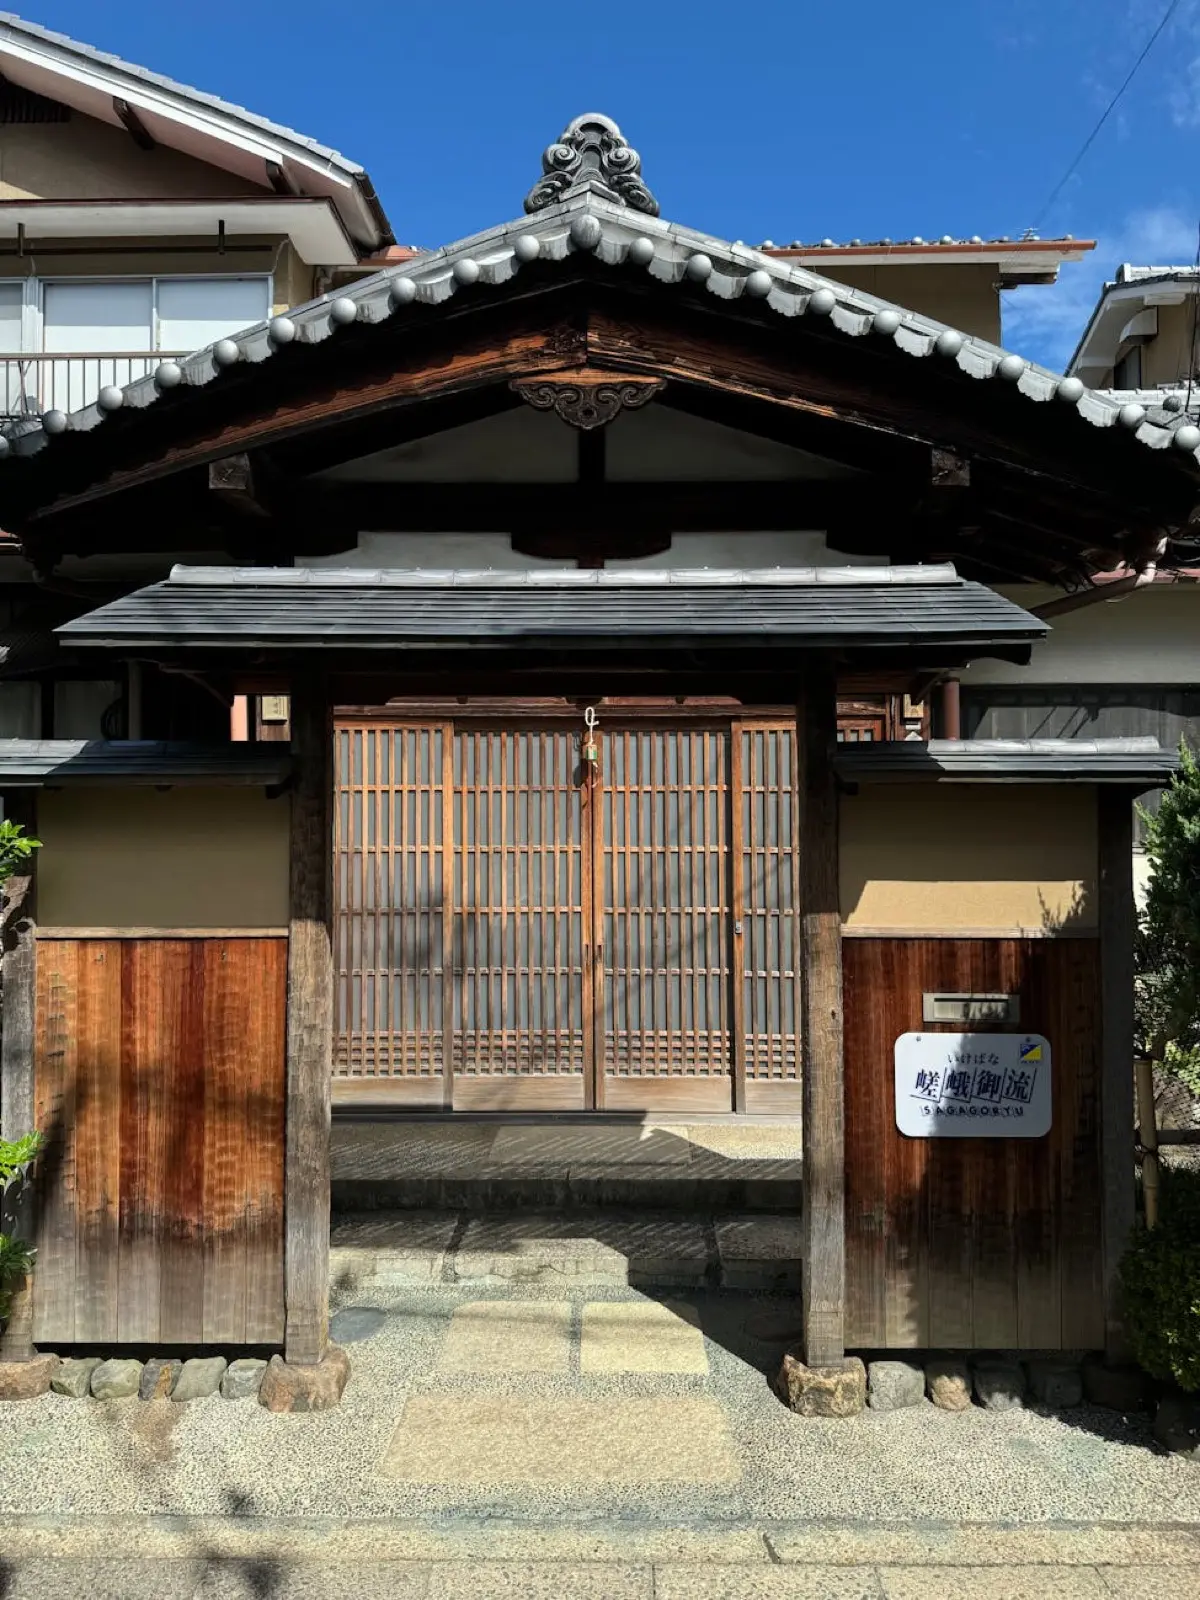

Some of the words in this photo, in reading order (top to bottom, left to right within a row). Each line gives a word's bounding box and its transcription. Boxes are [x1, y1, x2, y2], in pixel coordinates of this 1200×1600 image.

[915, 1068, 1030, 1100] 嵯峨御流
[923, 1105, 1024, 1115] SAGAGORYU
